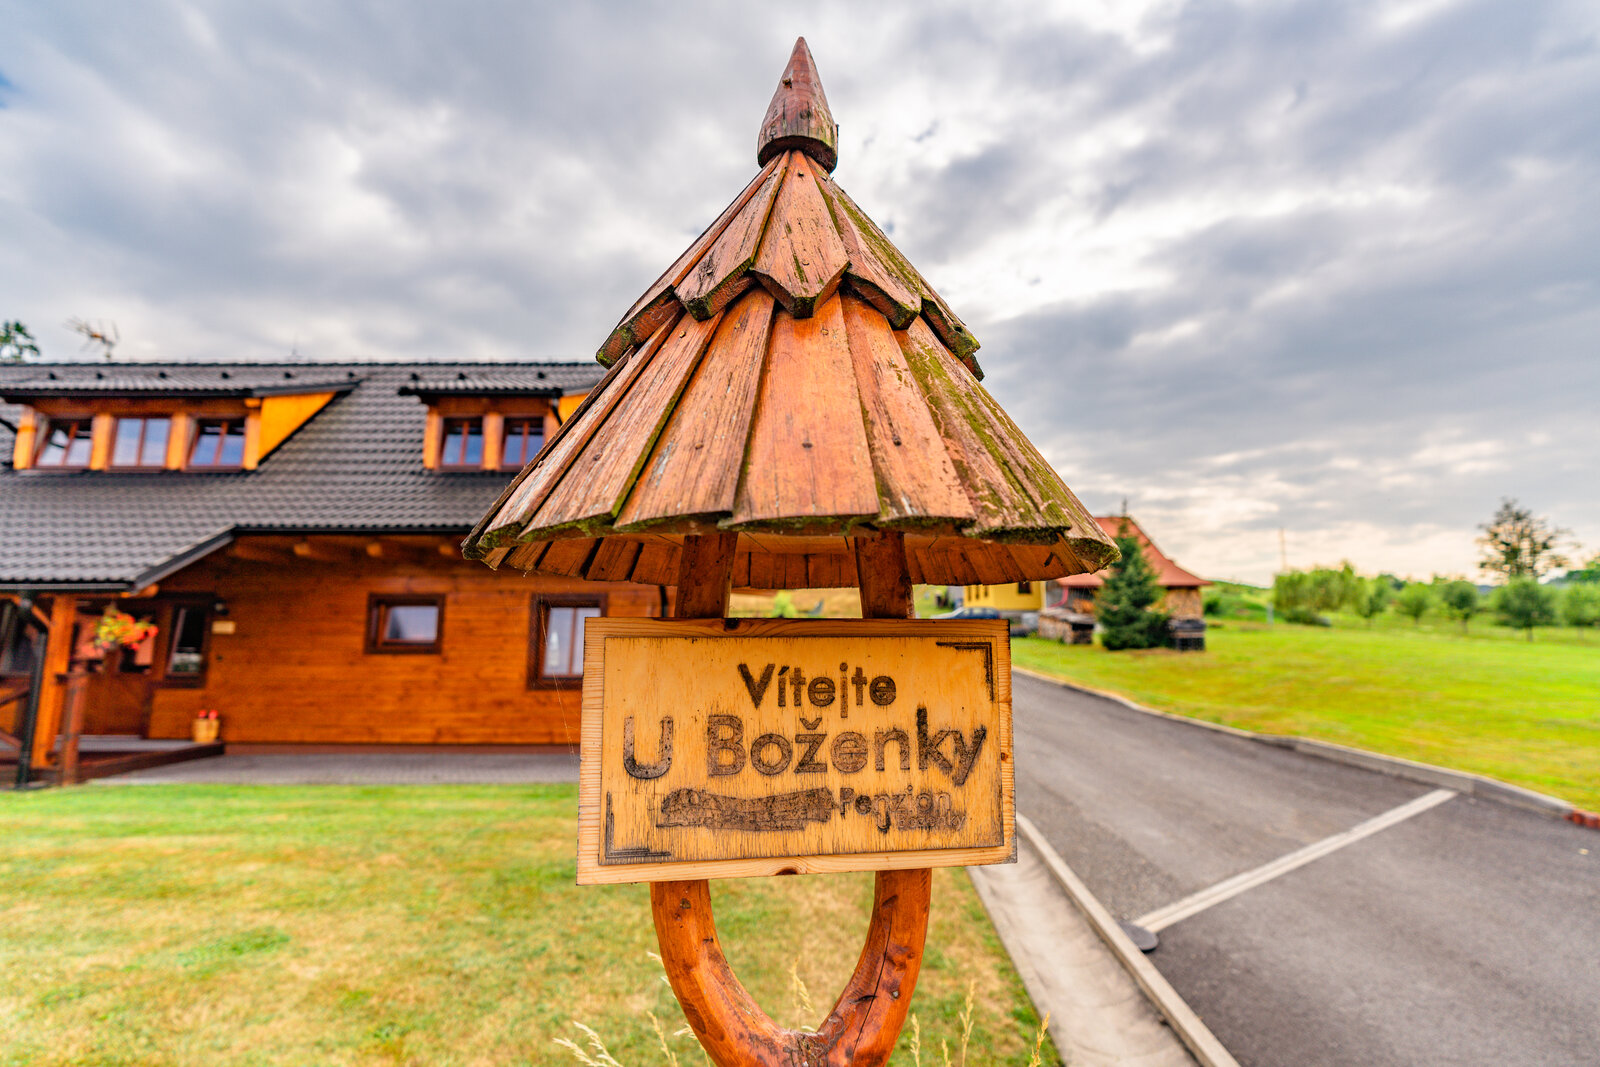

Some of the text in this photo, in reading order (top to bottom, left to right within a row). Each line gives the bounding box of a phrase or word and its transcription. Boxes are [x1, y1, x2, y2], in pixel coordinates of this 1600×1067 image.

[738, 663, 897, 718] Vítejte
[623, 707, 987, 786] U Boženky
[840, 784, 951, 816] Penzion
